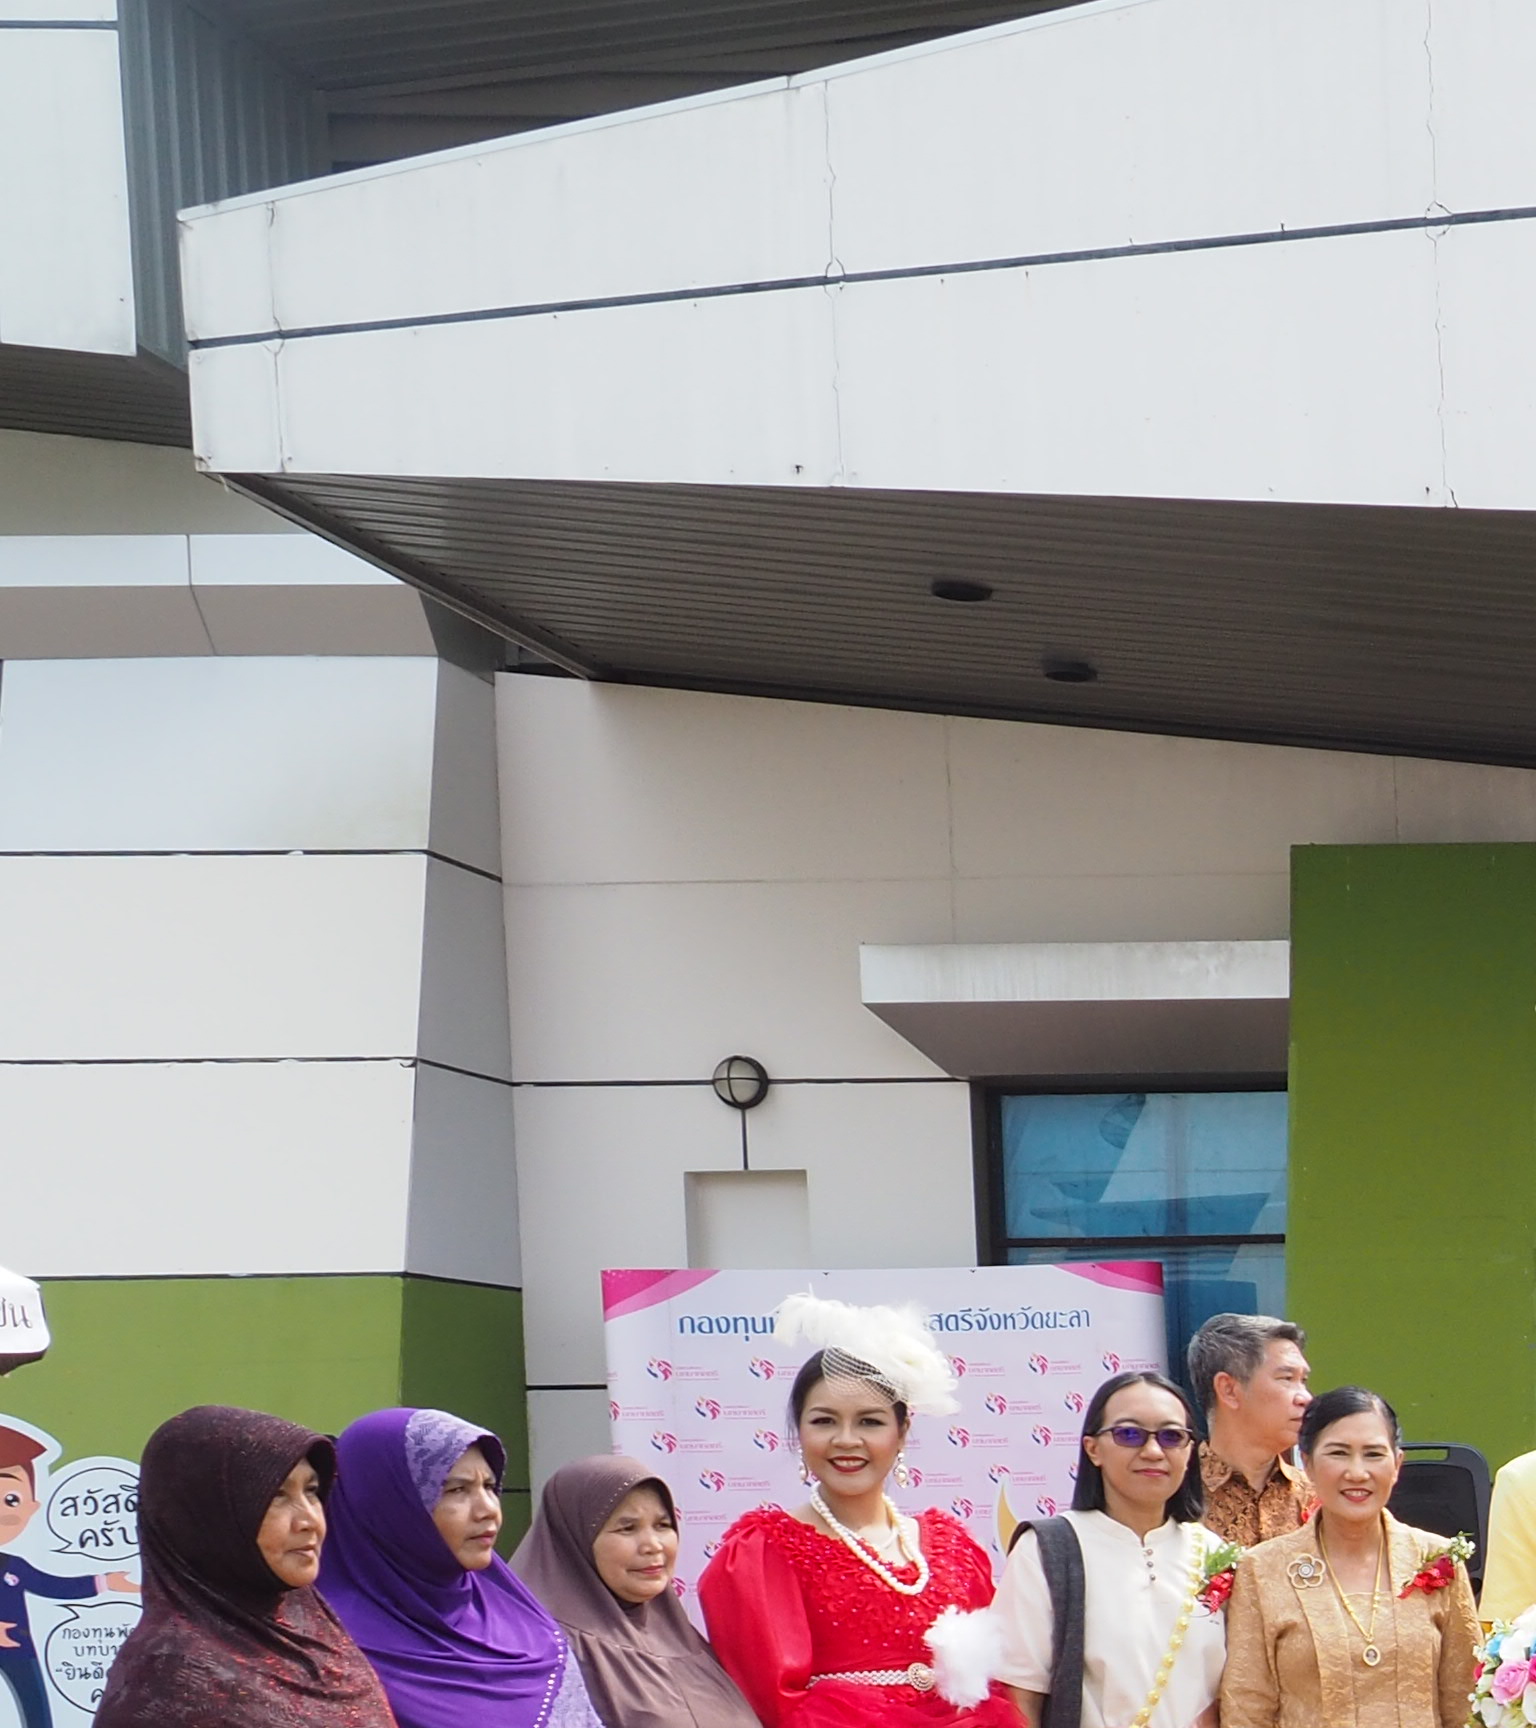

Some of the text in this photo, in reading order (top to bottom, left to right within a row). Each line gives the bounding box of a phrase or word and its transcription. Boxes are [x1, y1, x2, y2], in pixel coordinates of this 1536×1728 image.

[679, 1305, 1091, 1342] กองทุน สตรีจังหวัดยะลา
